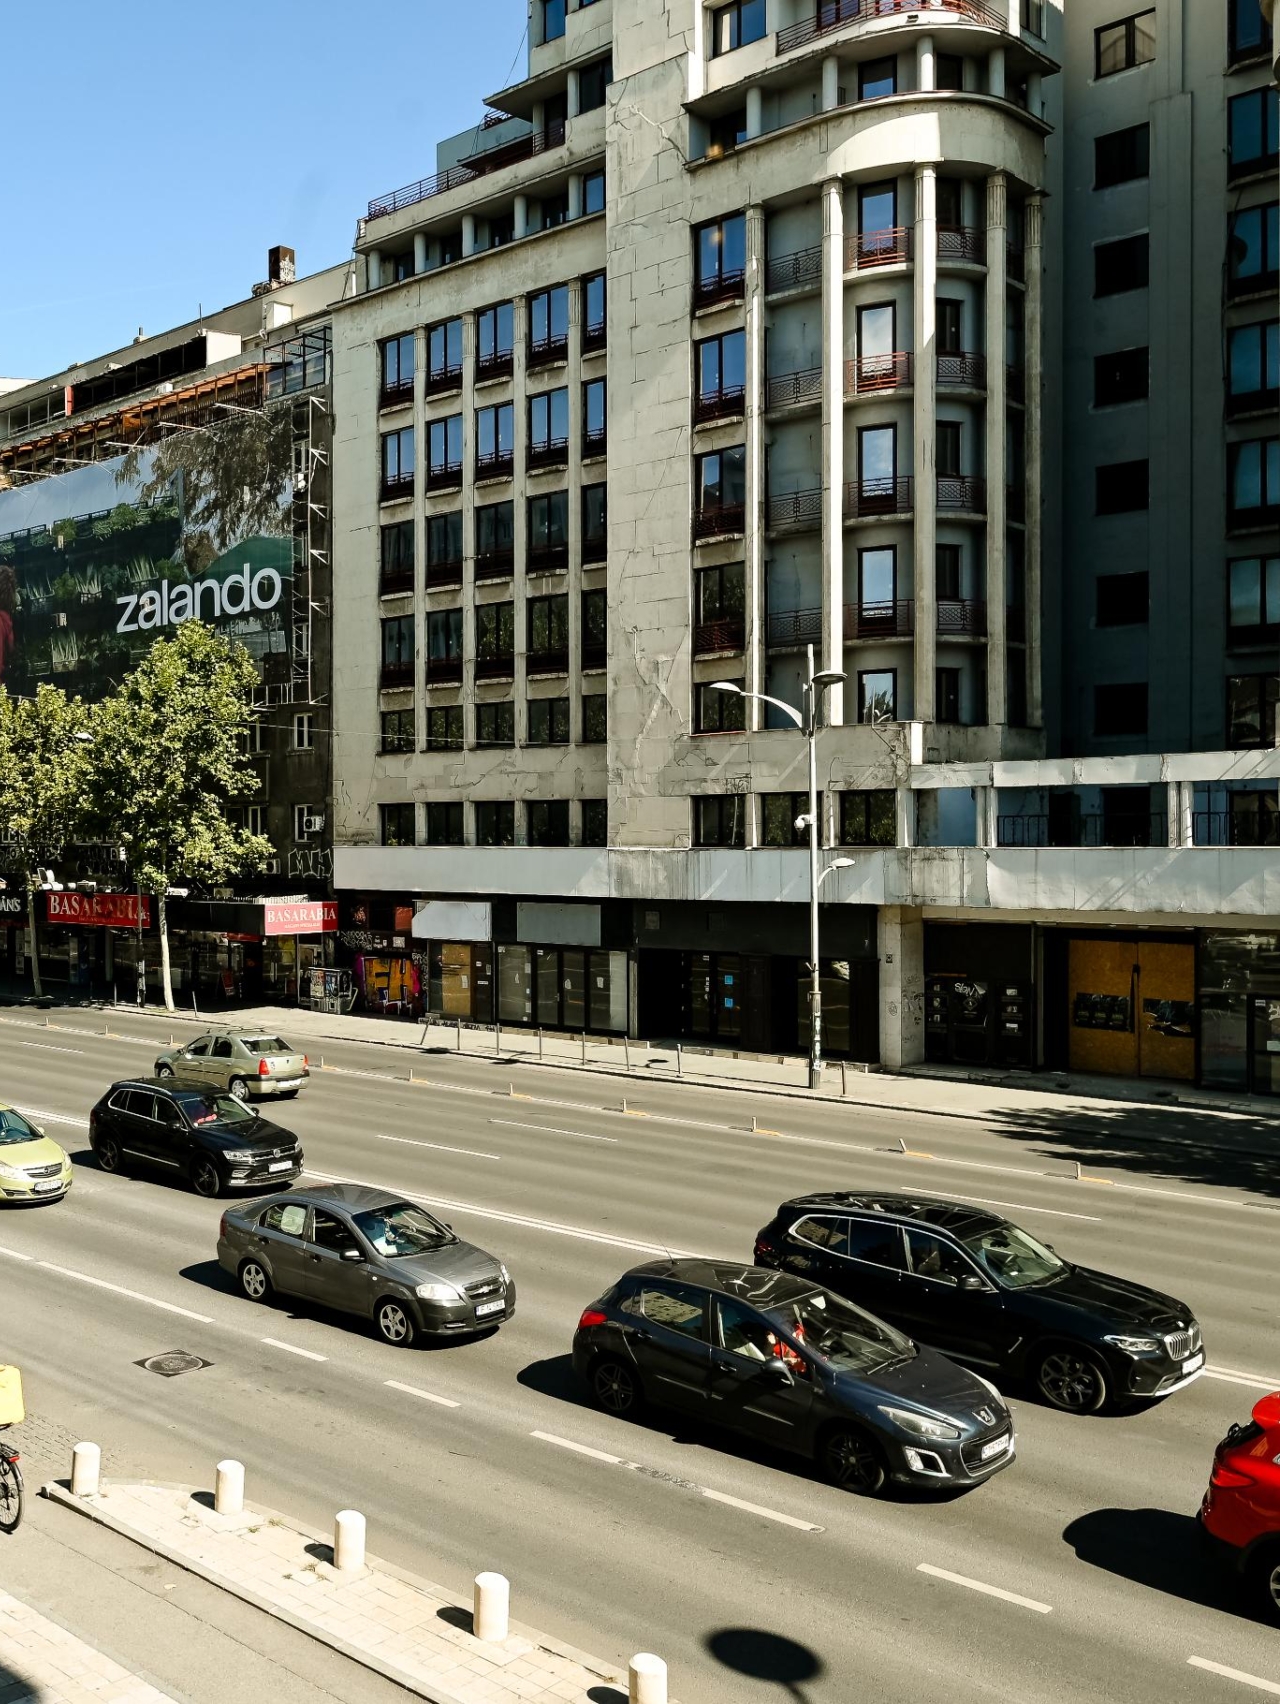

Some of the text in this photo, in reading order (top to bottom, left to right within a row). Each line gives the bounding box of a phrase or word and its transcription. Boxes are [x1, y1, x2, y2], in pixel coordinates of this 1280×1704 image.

[116, 562, 282, 633] zalando
[49, 895, 147, 919] BASARABIA
[266, 908, 337, 923] BASARABIA
